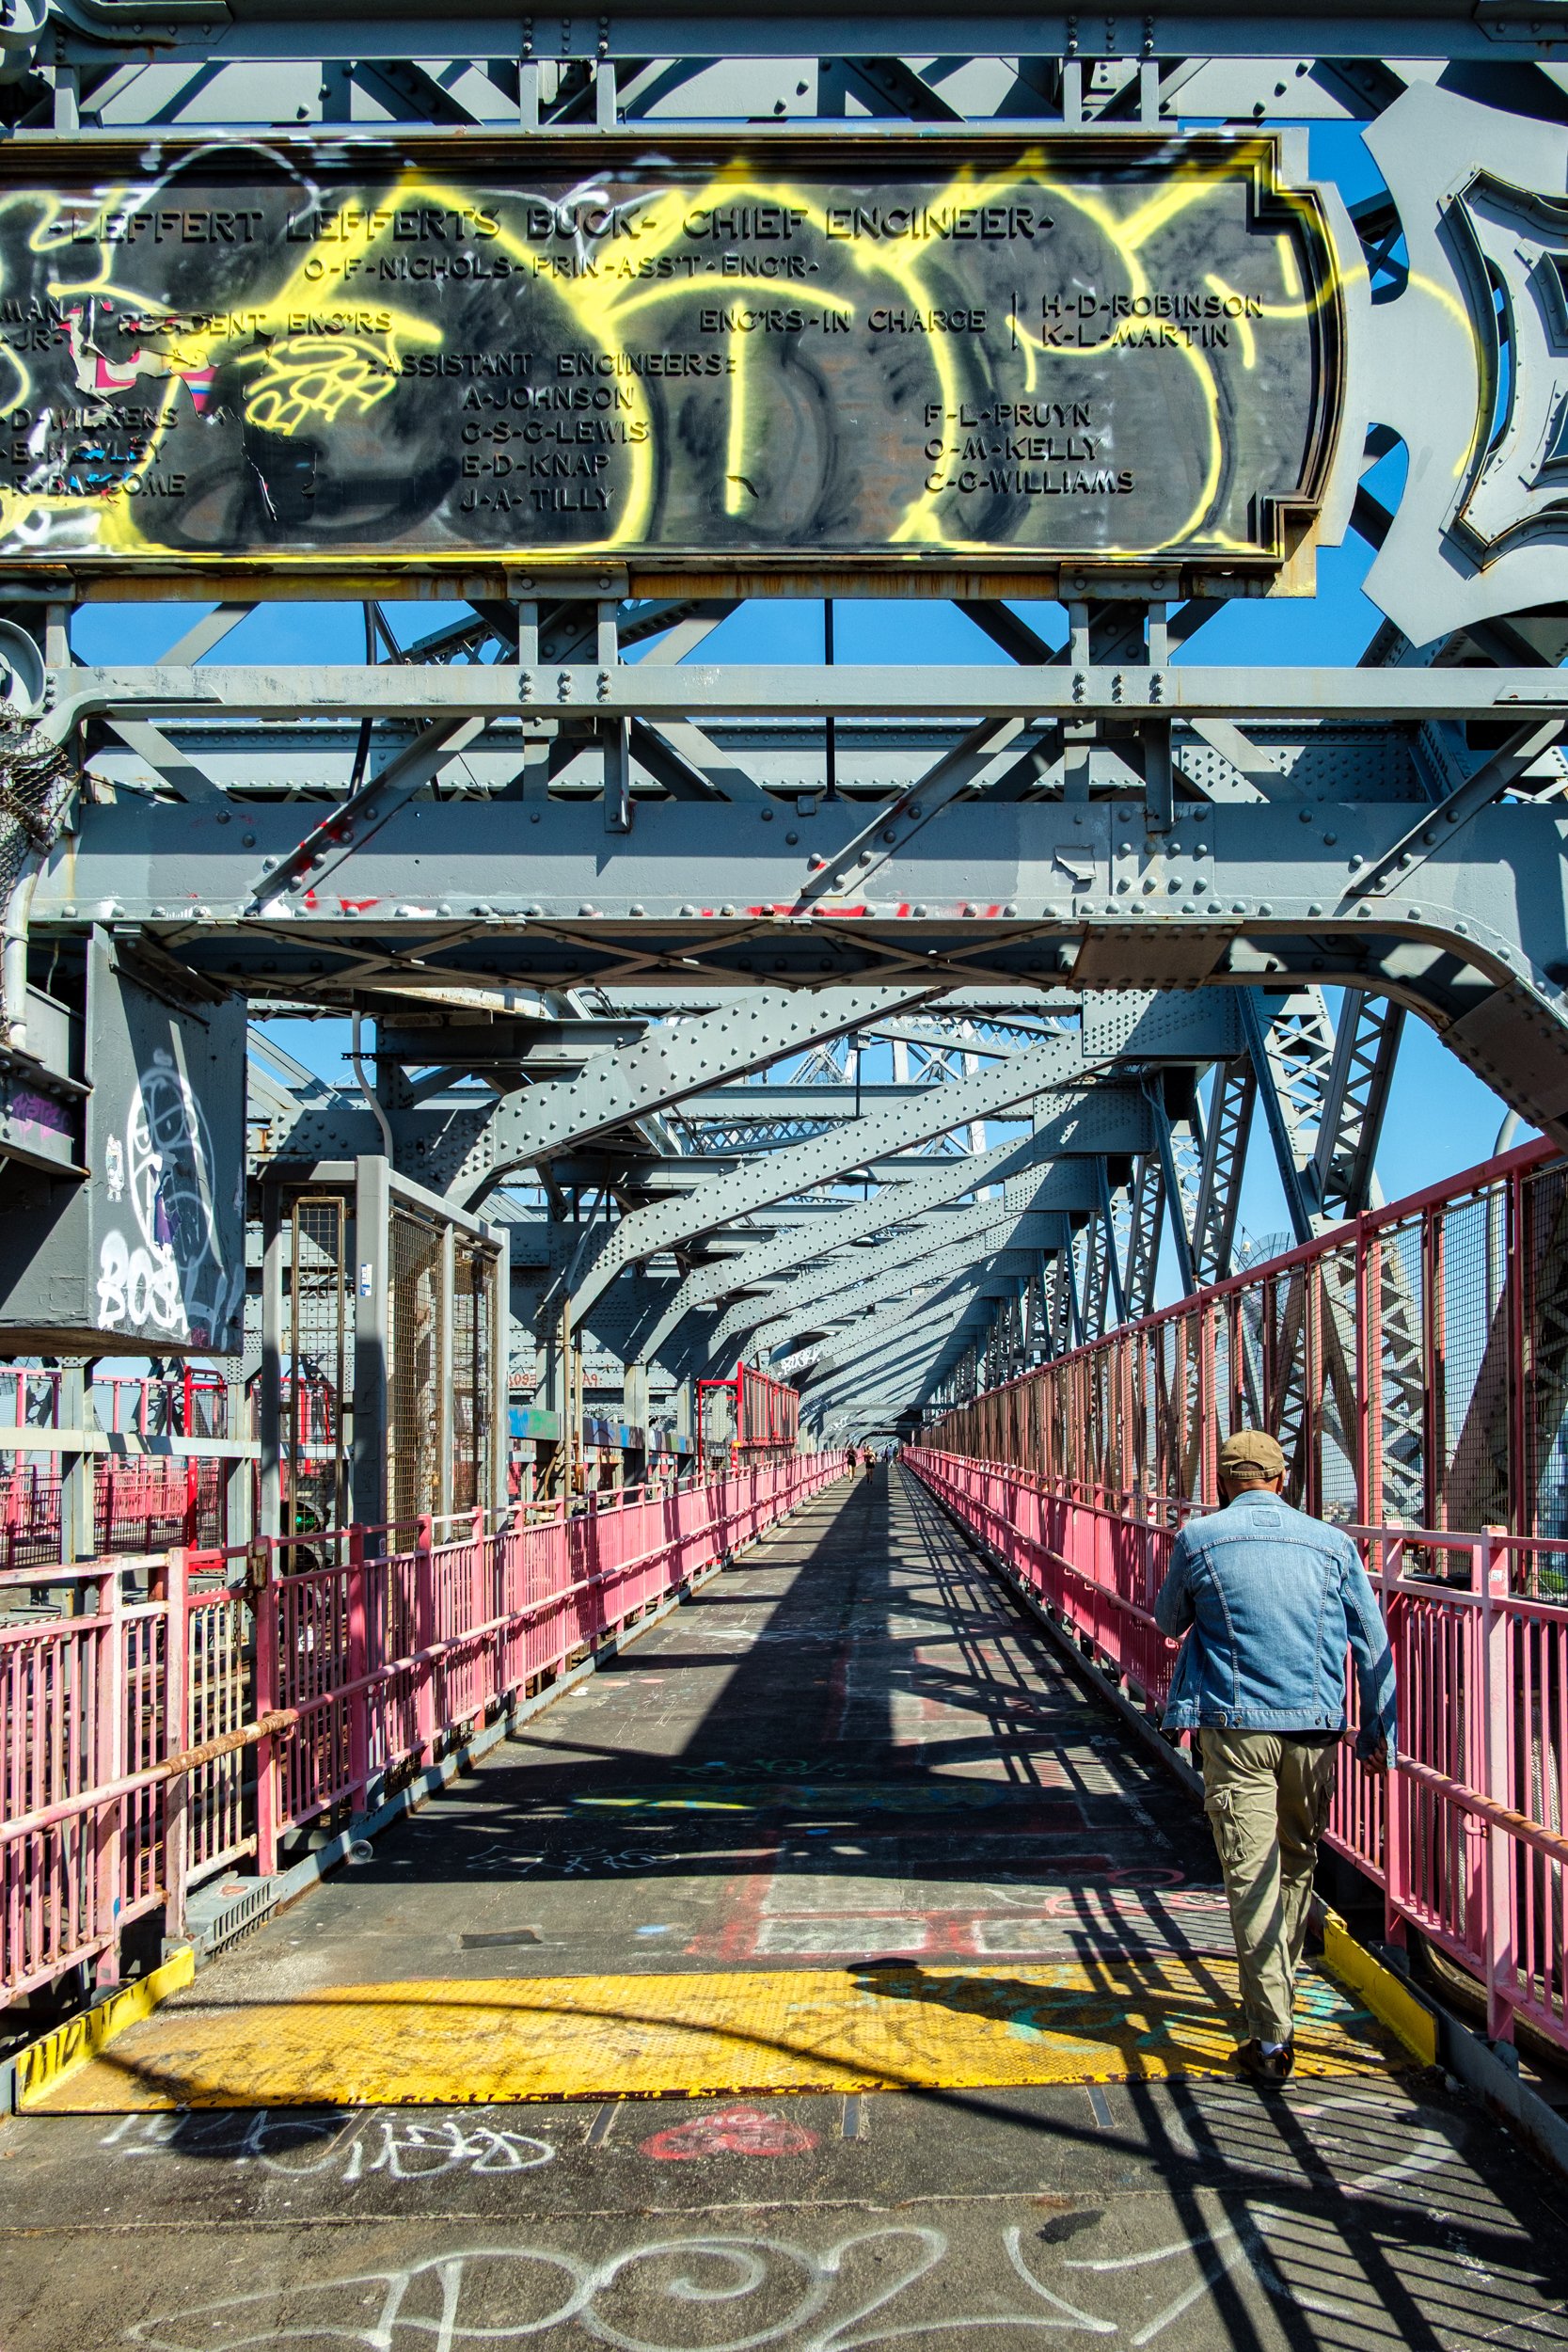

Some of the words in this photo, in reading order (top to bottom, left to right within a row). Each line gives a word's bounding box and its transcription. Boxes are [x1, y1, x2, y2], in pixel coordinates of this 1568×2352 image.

[286, 209, 501, 243] LEFFERTS
[683, 206, 809, 240] CHIEF
[867, 308, 988, 334] CHARGE
[530, 487, 615, 513] TILLY
